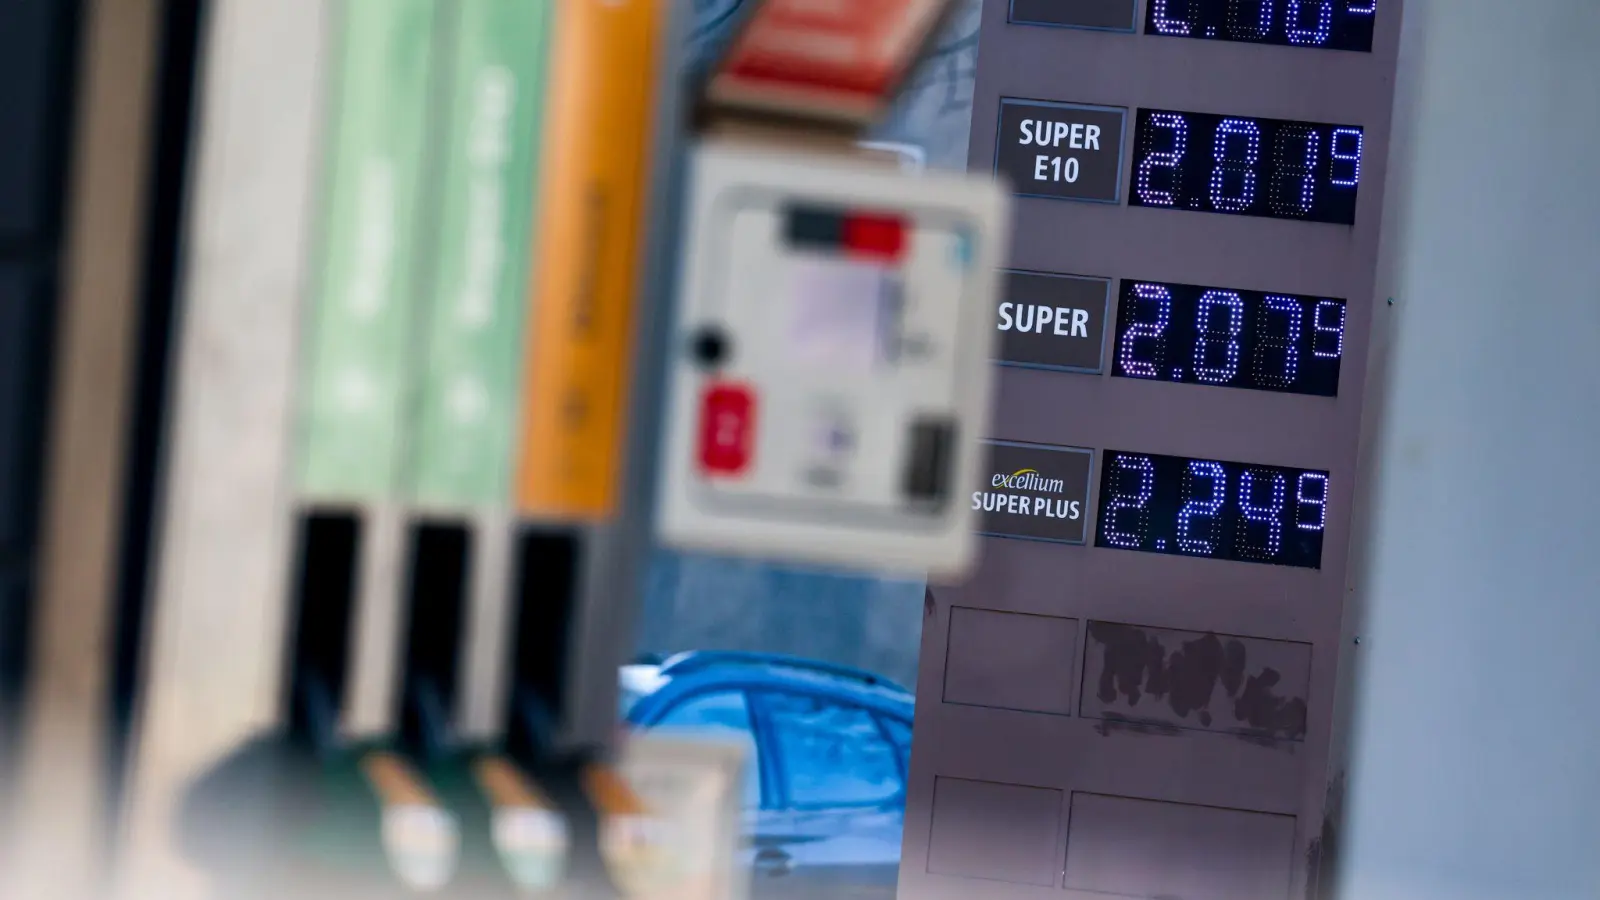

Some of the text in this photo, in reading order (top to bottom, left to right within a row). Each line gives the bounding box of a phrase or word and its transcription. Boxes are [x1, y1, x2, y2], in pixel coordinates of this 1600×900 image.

[1019, 119, 1100, 151] SUPER
[1034, 155, 1079, 183] E10
[997, 301, 1089, 338] SUPER
[992, 472, 1064, 493] excellium
[971, 491, 1080, 520] SUPER PLUS
